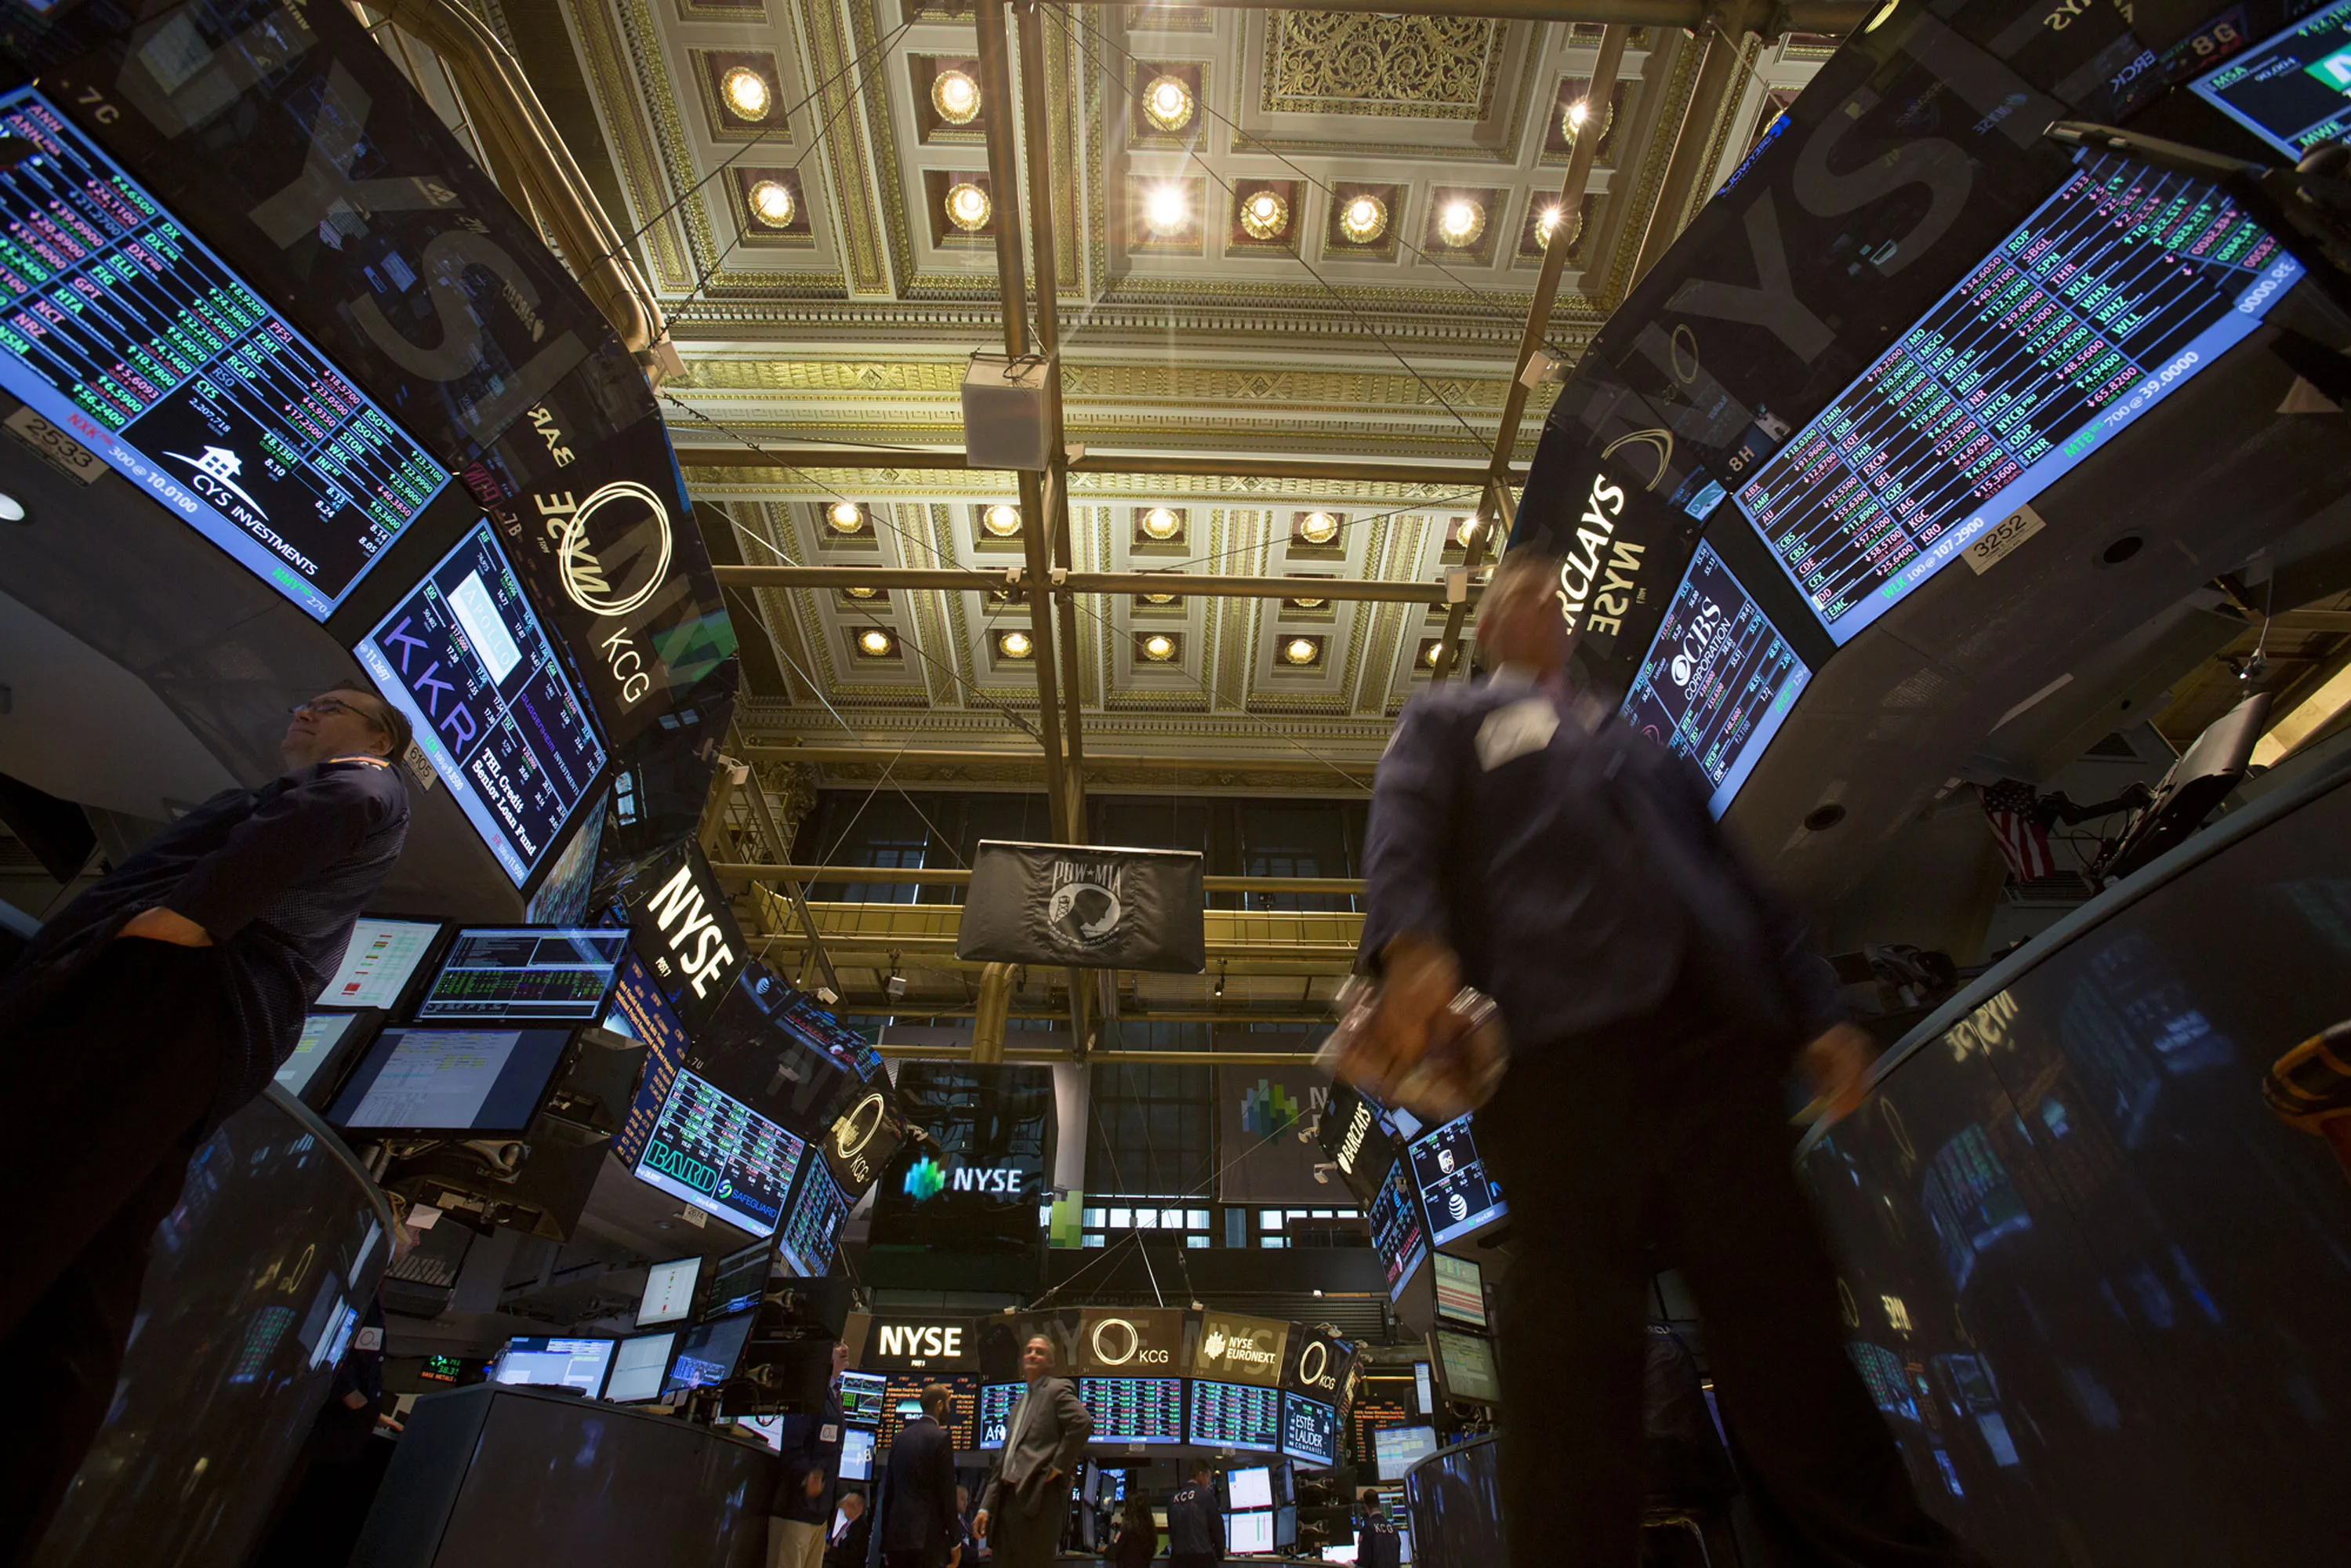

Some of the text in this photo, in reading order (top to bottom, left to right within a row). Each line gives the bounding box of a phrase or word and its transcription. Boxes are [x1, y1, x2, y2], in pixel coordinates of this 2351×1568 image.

[161, 223, 181, 239] DX
[2008, 229, 2030, 252] ROP
[2023, 238, 2052, 263] SBGL
[92, 265, 116, 285] FIG
[110, 253, 138, 278] ELLI
[1965, 256, 2002, 291] 34.6050
[2036, 252, 2061, 275] SPN
[2050, 263, 2077, 285] THR
[74, 277, 102, 299] GPT
[1979, 267, 2015, 301] 40.5100
[2064, 272, 2095, 297] WLK
[2080, 283, 2112, 309] WHX
[54, 288, 84, 314] HTA
[1986, 278, 2029, 317] 112.1600
[2005, 290, 2044, 325] 39.0000
[2095, 296, 2128, 321] WHZ
[34, 300, 66, 323] NCT
[2025, 303, 2059, 332] 2.5001
[2111, 313, 2142, 335] WLL
[14, 313, 47, 338] NRZ
[270, 321, 293, 343] PFSI
[1908, 330, 1925, 346] MO
[2034, 314, 2073, 349] 12.5500
[241, 344, 264, 364] RAS
[256, 333, 281, 354] PMT
[1920, 333, 1945, 358] MSCI
[2048, 327, 2088, 361] 15.4500
[227, 355, 256, 379] RCAP
[1872, 348, 1903, 378] 79.2500
[1932, 347, 1954, 368] MTB
[2064, 339, 2104, 375] 48.5600
[2084, 353, 2120, 383] 4.9400
[1882, 360, 1914, 390] 50.0000
[1943, 359, 1967, 382] MTB
[1956, 370, 1982, 393] MUX
[196, 380, 219, 399] CYS
[329, 375, 361, 405] 18.5700
[1894, 371, 1926, 402] 88.6800
[2095, 366, 2137, 401] 65.8200
[315, 387, 349, 416] 23.0500
[1905, 383, 1939, 413] 11.1400
[1969, 389, 1988, 405] NR
[1982, 392, 2012, 419] NYCB
[2063, 351, 2199, 458] MTB 700 39.0000
[307, 401, 336, 427] 6.9350
[1821, 405, 1842, 427] EMN
[1917, 395, 1950, 426] 19.6800
[1933, 408, 1963, 435] 4.4400
[1996, 394, 2037, 431] NYCB PRU
[290, 409, 324, 440] 17.2500
[1832, 419, 1852, 437] EQM
[1941, 421, 1975, 451] 22.3300
[2009, 424, 2032, 445] ODP
[25, 419, 93, 467] 2533
[339, 432, 366, 454] STON
[1842, 432, 1860, 450] EQT
[1852, 443, 1873, 463] FHN
[1959, 434, 1990, 460] 4.6700
[2023, 437, 2049, 459] PNR
[328, 443, 351, 465] WAC
[1863, 452, 1888, 477] FXCM
[1972, 447, 2003, 474] 4.9300
[264, 458, 286, 477] 8.10
[1874, 472, 1891, 488] GFI
[1979, 461, 2018, 492] 15.3600
[147, 471, 198, 514] 10.0100
[326, 487, 345, 503] 8.13
[1744, 481, 1761, 500] ABX
[1753, 492, 1769, 511] AMP
[1828, 477, 1857, 504] 55.5500
[1885, 482, 1903, 501] GXP
[315, 500, 336, 518] 8.24
[1838, 490, 1868, 517] 55.6300
[1897, 497, 1915, 514] IAG
[193, 474, 318, 575] CYS INVESTMENTS
[1761, 510, 1774, 524] AU
[1848, 503, 1879, 530] 11.8900
[1908, 509, 1929, 528] KGC
[370, 524, 388, 541] 8.14
[1780, 532, 1796, 548] CBS
[1859, 517, 1891, 545] 57.1500
[1920, 523, 1941, 543] KRO
[1974, 515, 2026, 557] 3252
[359, 536, 377, 554] 8.05
[1555, 474, 1624, 636] RCLAYS
[1870, 531, 1902, 559] 58.5100
[1799, 557, 1816, 574] CDE
[1881, 544, 1914, 572] 25.6400
[1881, 517, 1985, 601] WLK 100 107.2900
[1808, 572, 1825, 588] CFX
[1819, 588, 1832, 601] DD
[1828, 597, 1849, 617] EMC
[465, 589, 512, 666] APOLLO
[1683, 597, 1721, 664] CBS
[601, 627, 649, 702] KCG
[1685, 618, 1732, 701] CORPORATION
[384, 615, 477, 754] KKR
[409, 746, 431, 778] 6105
[553, 752, 580, 796] INVESTMENTS
[482, 747, 524, 813] THL Credit
[472, 760, 537, 856] Senior Loan Fund
[1051, 861, 1122, 900] POW MIA
[648, 865, 734, 1000] NYSE
[1343, 1102, 1371, 1163] BARCLAYS
[645, 1139, 717, 1192] BARD
[850, 1153, 869, 1184] KCG
[953, 1167, 1023, 1192] NYSE
[731, 1189, 778, 1219] SAFEGUARD
[879, 1326, 963, 1357] NYSE
[1228, 1336, 1254, 1350] NYSE
[1139, 1349, 1169, 1363] KCG
[1319, 1374, 1336, 1390] KCG
[1295, 1429, 1322, 1447] LAUDER
[1295, 1443, 1322, 1454] COMPANIES
[1174, 1490, 1195, 1504] KCG
[1373, 1523, 1393, 1534] KCG
